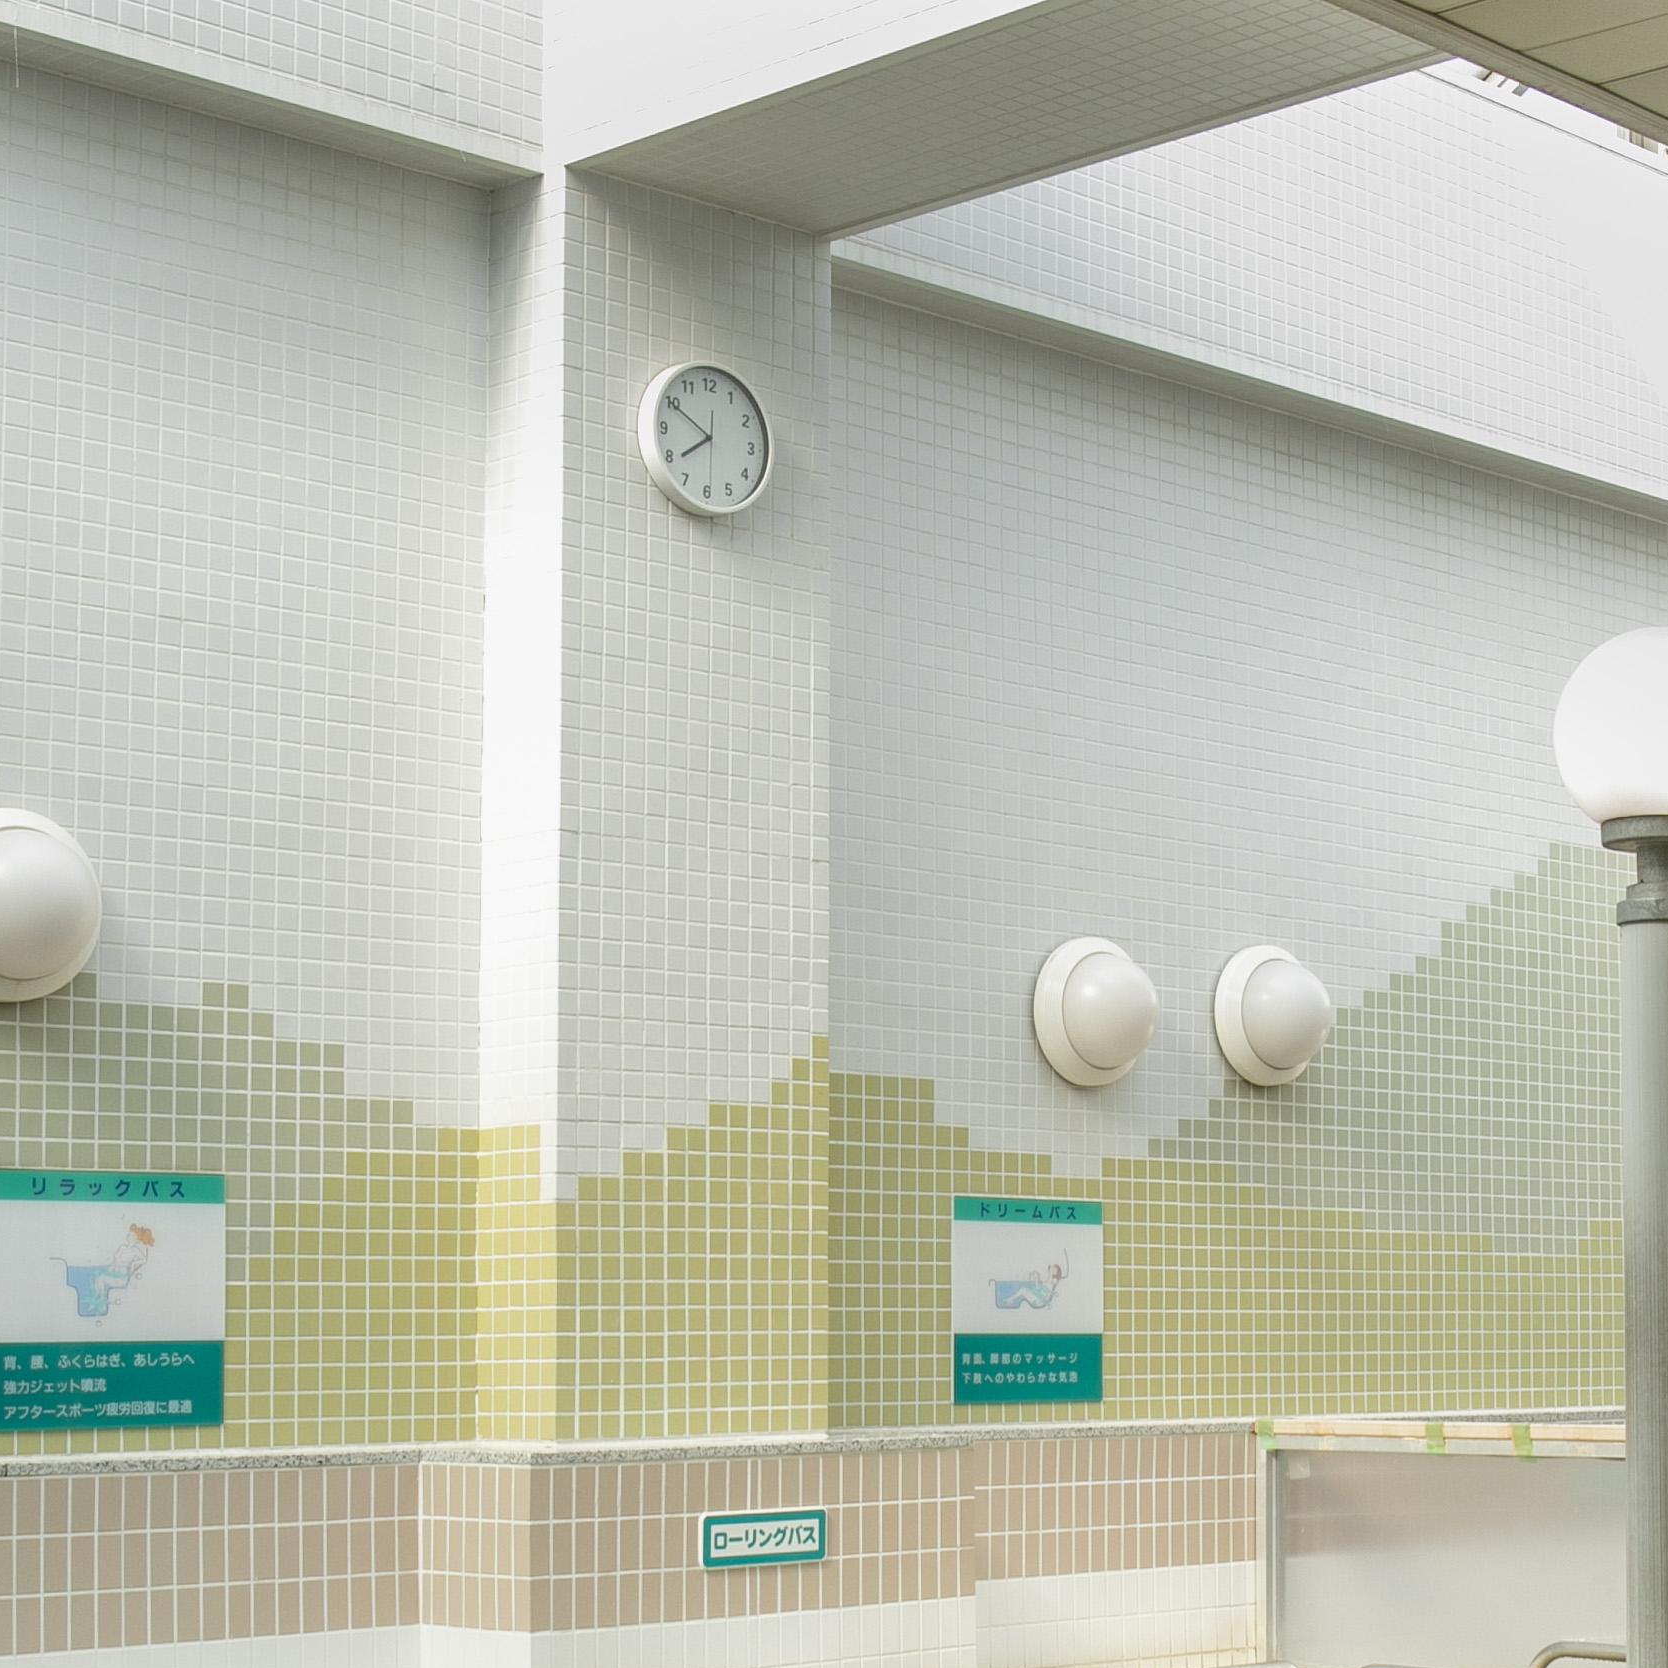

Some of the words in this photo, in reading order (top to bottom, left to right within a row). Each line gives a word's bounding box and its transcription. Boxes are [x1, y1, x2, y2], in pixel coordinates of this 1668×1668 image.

[681, 380, 694, 395] 11
[702, 378, 717, 393] 12
[665, 395, 680, 409] 10
[727, 391, 733, 405] 1
[660, 421, 668, 435] 9
[741, 414, 750, 428] 2
[665, 449, 673, 463] 8
[747, 442, 755, 456] 3
[681, 473, 689, 486] 7
[741, 467, 749, 481] 4
[703, 485, 711, 498] 6
[725, 483, 733, 497] 5
[31, 1177, 185, 1198] リラックバス
[980, 1202, 1077, 1220] ドリームバス
[3, 1378, 107, 1396] 強力ジェット噴流
[3, 1399, 192, 1420] アフタースポーツ疲労回復に最適
[714, 1525, 816, 1550] ローリングバス
